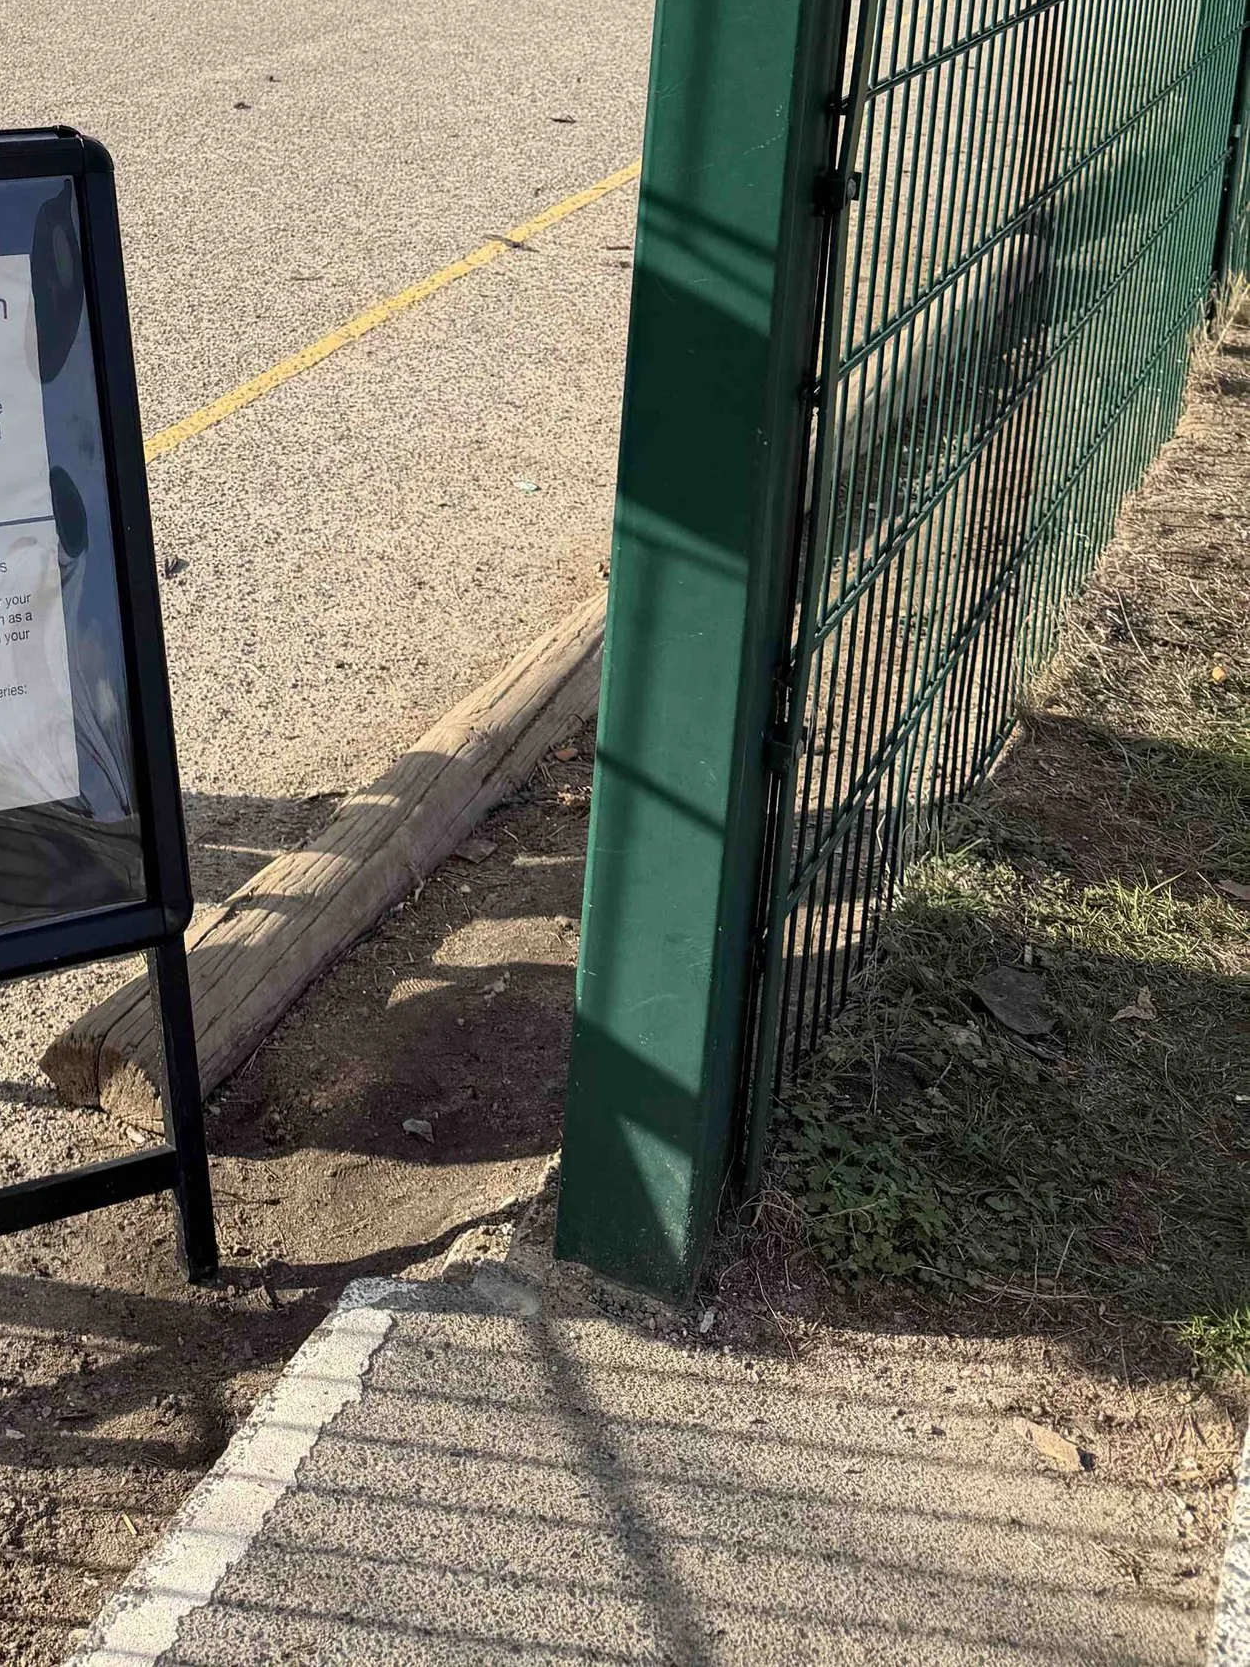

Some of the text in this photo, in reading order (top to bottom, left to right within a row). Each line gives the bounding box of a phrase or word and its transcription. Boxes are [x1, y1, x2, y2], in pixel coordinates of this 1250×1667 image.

[5, 593, 32, 612] your
[9, 611, 22, 625] as
[25, 610, 33, 622] a
[4, 629, 30, 649] your
